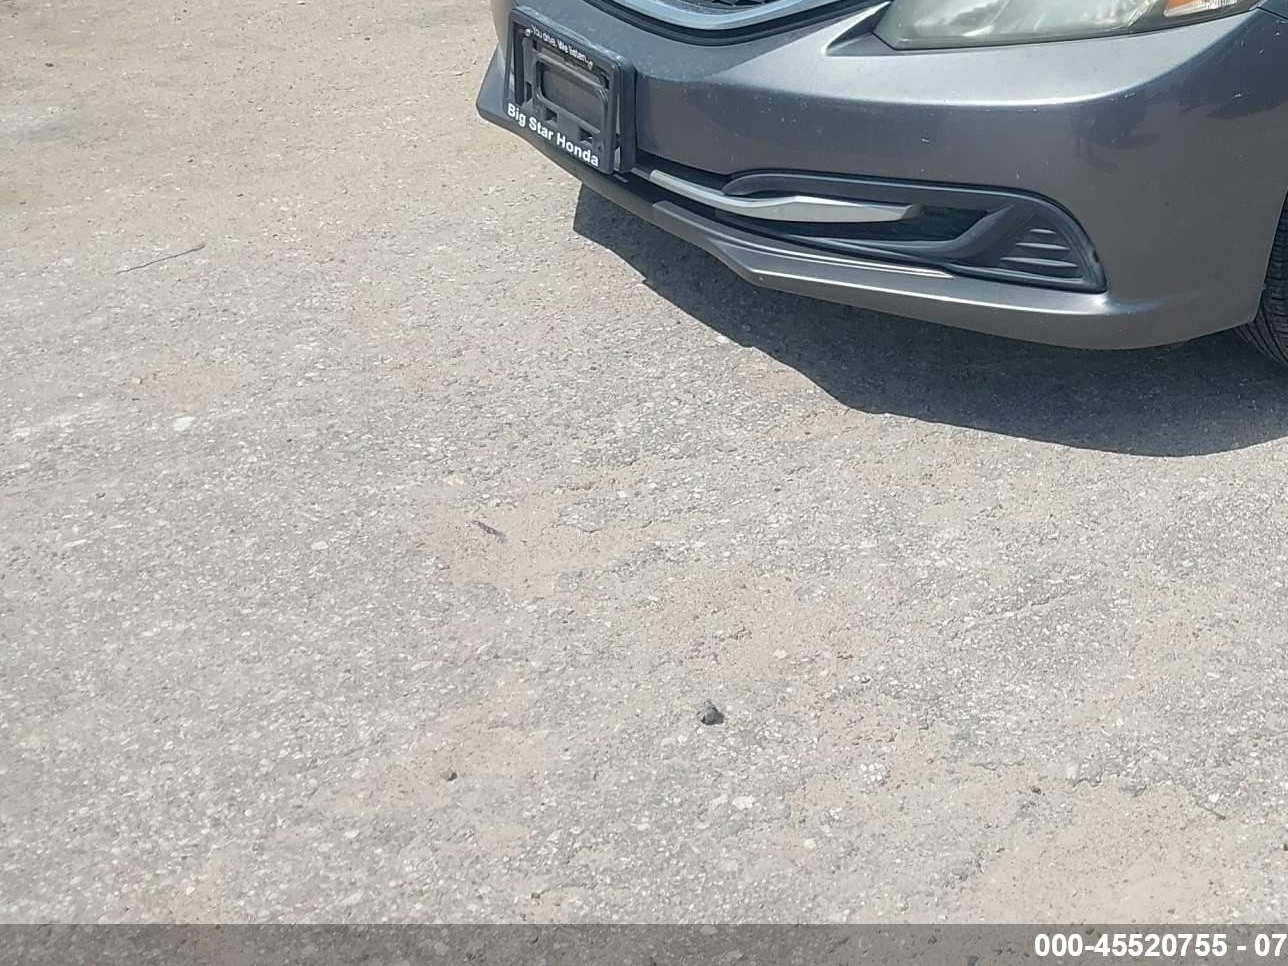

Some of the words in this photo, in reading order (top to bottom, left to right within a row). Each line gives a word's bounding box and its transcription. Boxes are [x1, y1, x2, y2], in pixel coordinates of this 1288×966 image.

[531, 24, 542, 39] You
[557, 39, 569, 54] We
[507, 102, 526, 127] Big
[529, 117, 554, 140] Star
[556, 132, 599, 167] Honda
